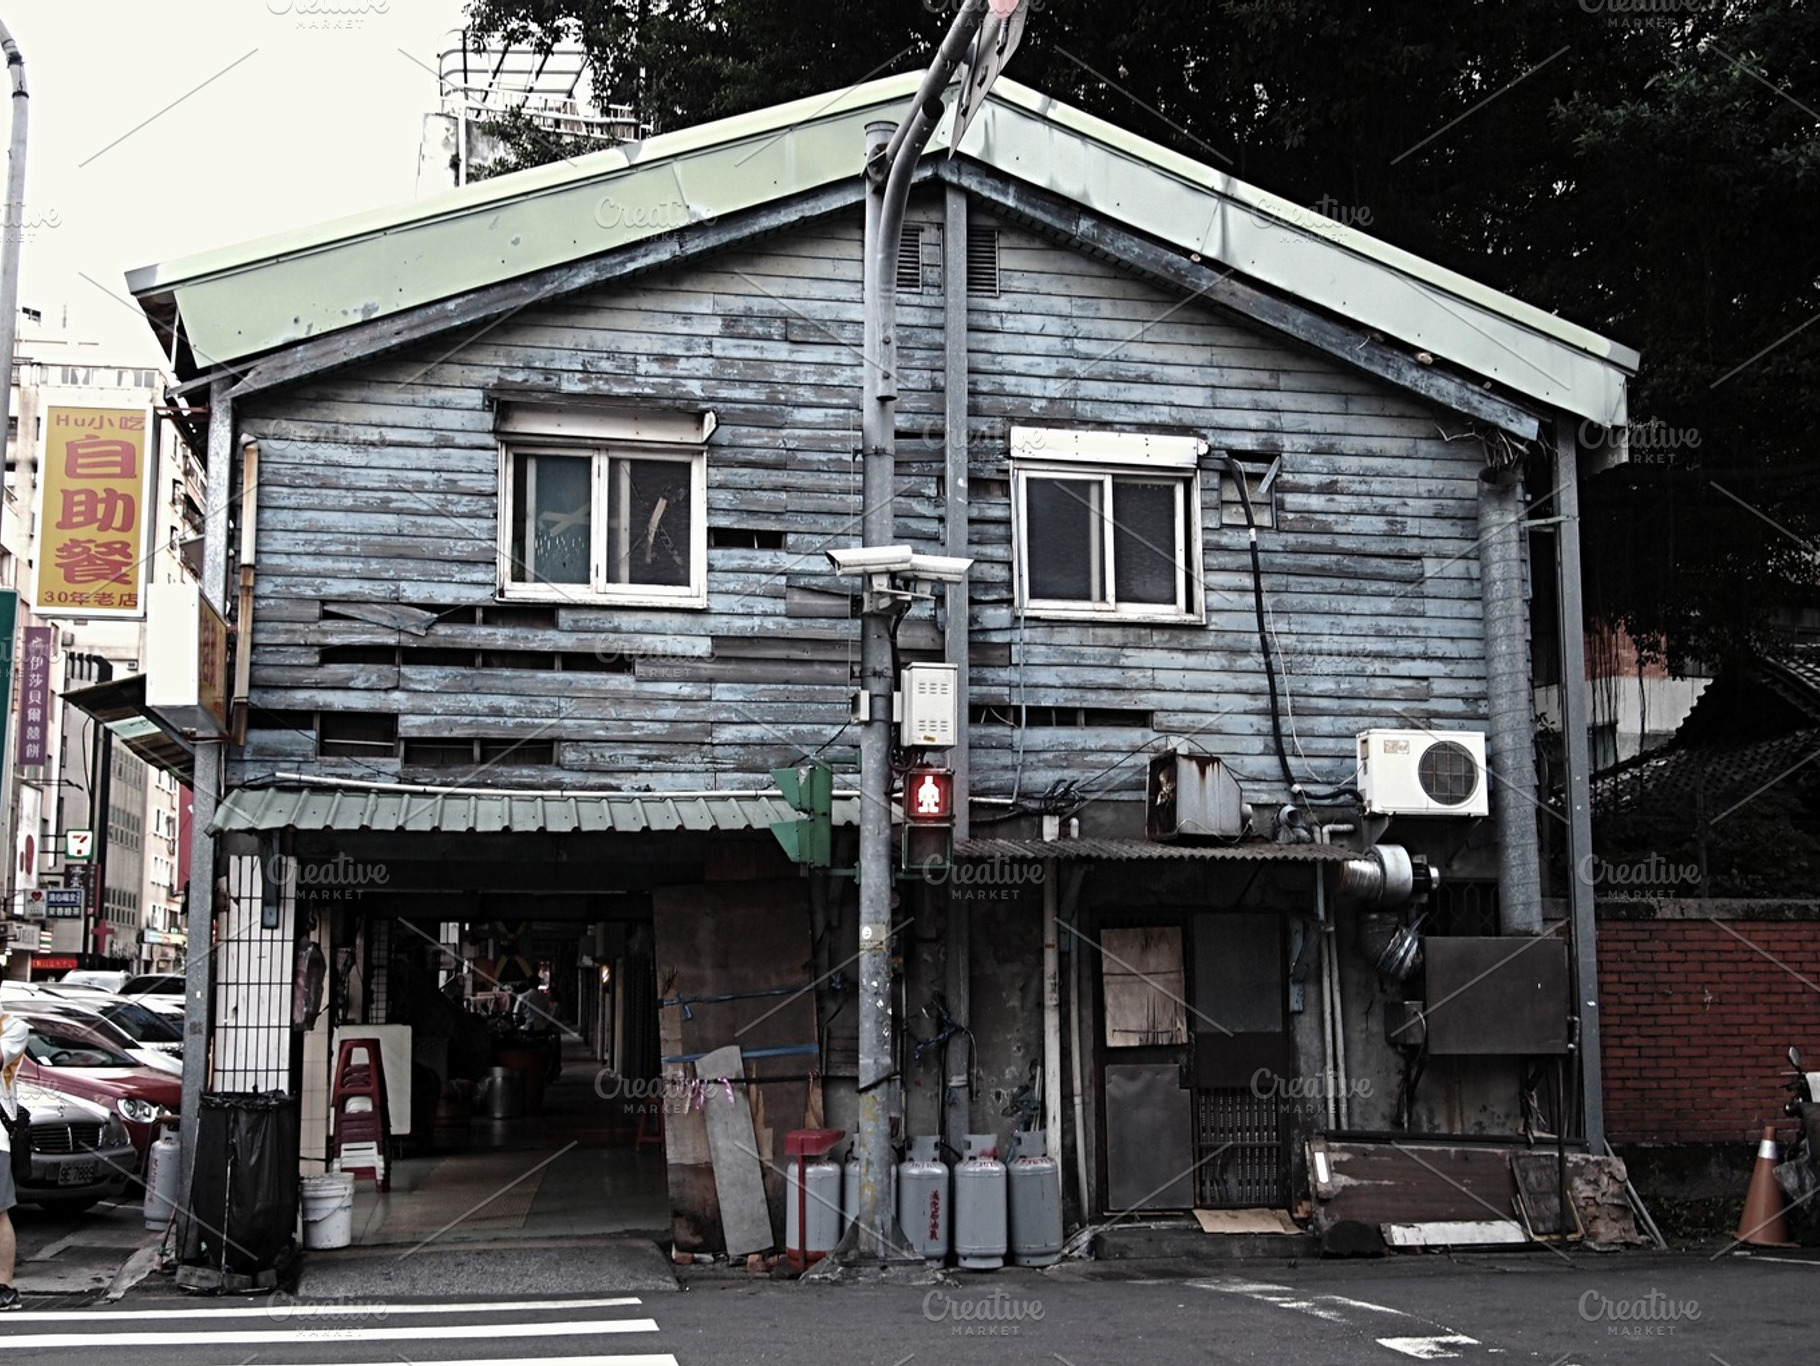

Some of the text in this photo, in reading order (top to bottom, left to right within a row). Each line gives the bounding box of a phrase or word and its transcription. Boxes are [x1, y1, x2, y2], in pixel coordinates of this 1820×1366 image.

[55, 413, 146, 431] Hu小吃
[55, 434, 138, 585] 自助餐
[44, 590, 138, 607] 30年老店
